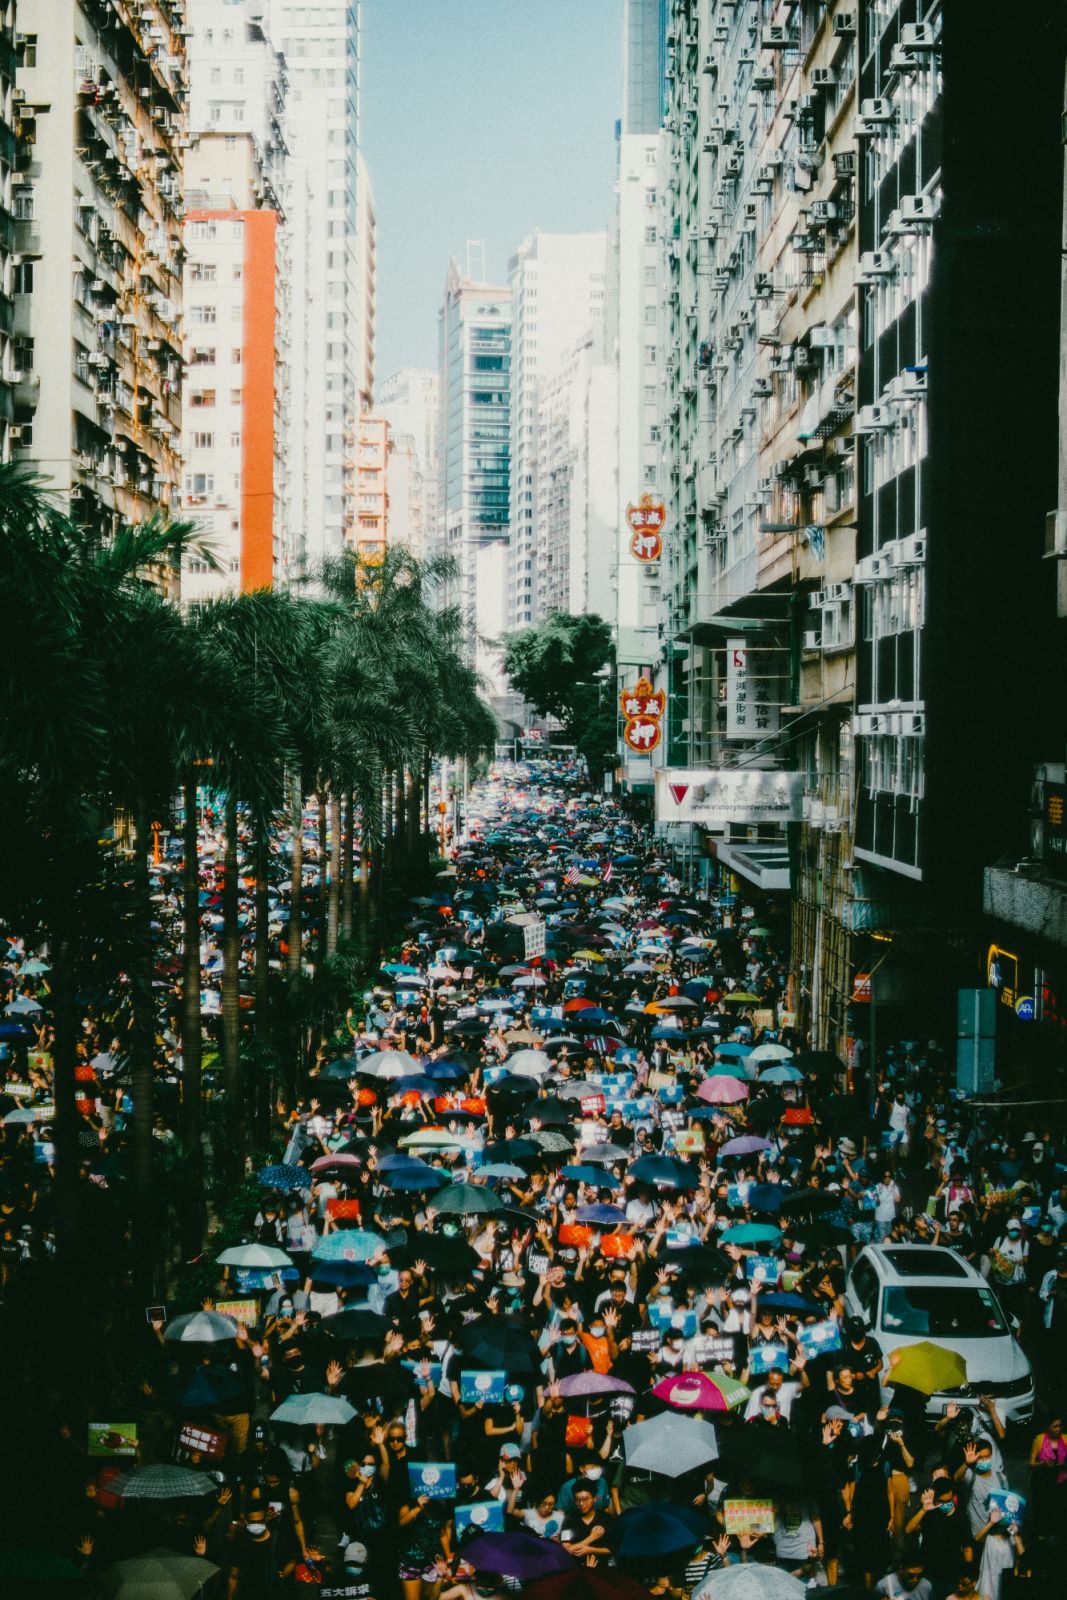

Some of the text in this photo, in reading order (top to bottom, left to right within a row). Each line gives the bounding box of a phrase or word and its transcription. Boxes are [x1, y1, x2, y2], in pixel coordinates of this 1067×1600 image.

[633, 532, 657, 558] 押
[629, 720, 656, 748] 押
[320, 1583, 370, 1597] 五大訴求
